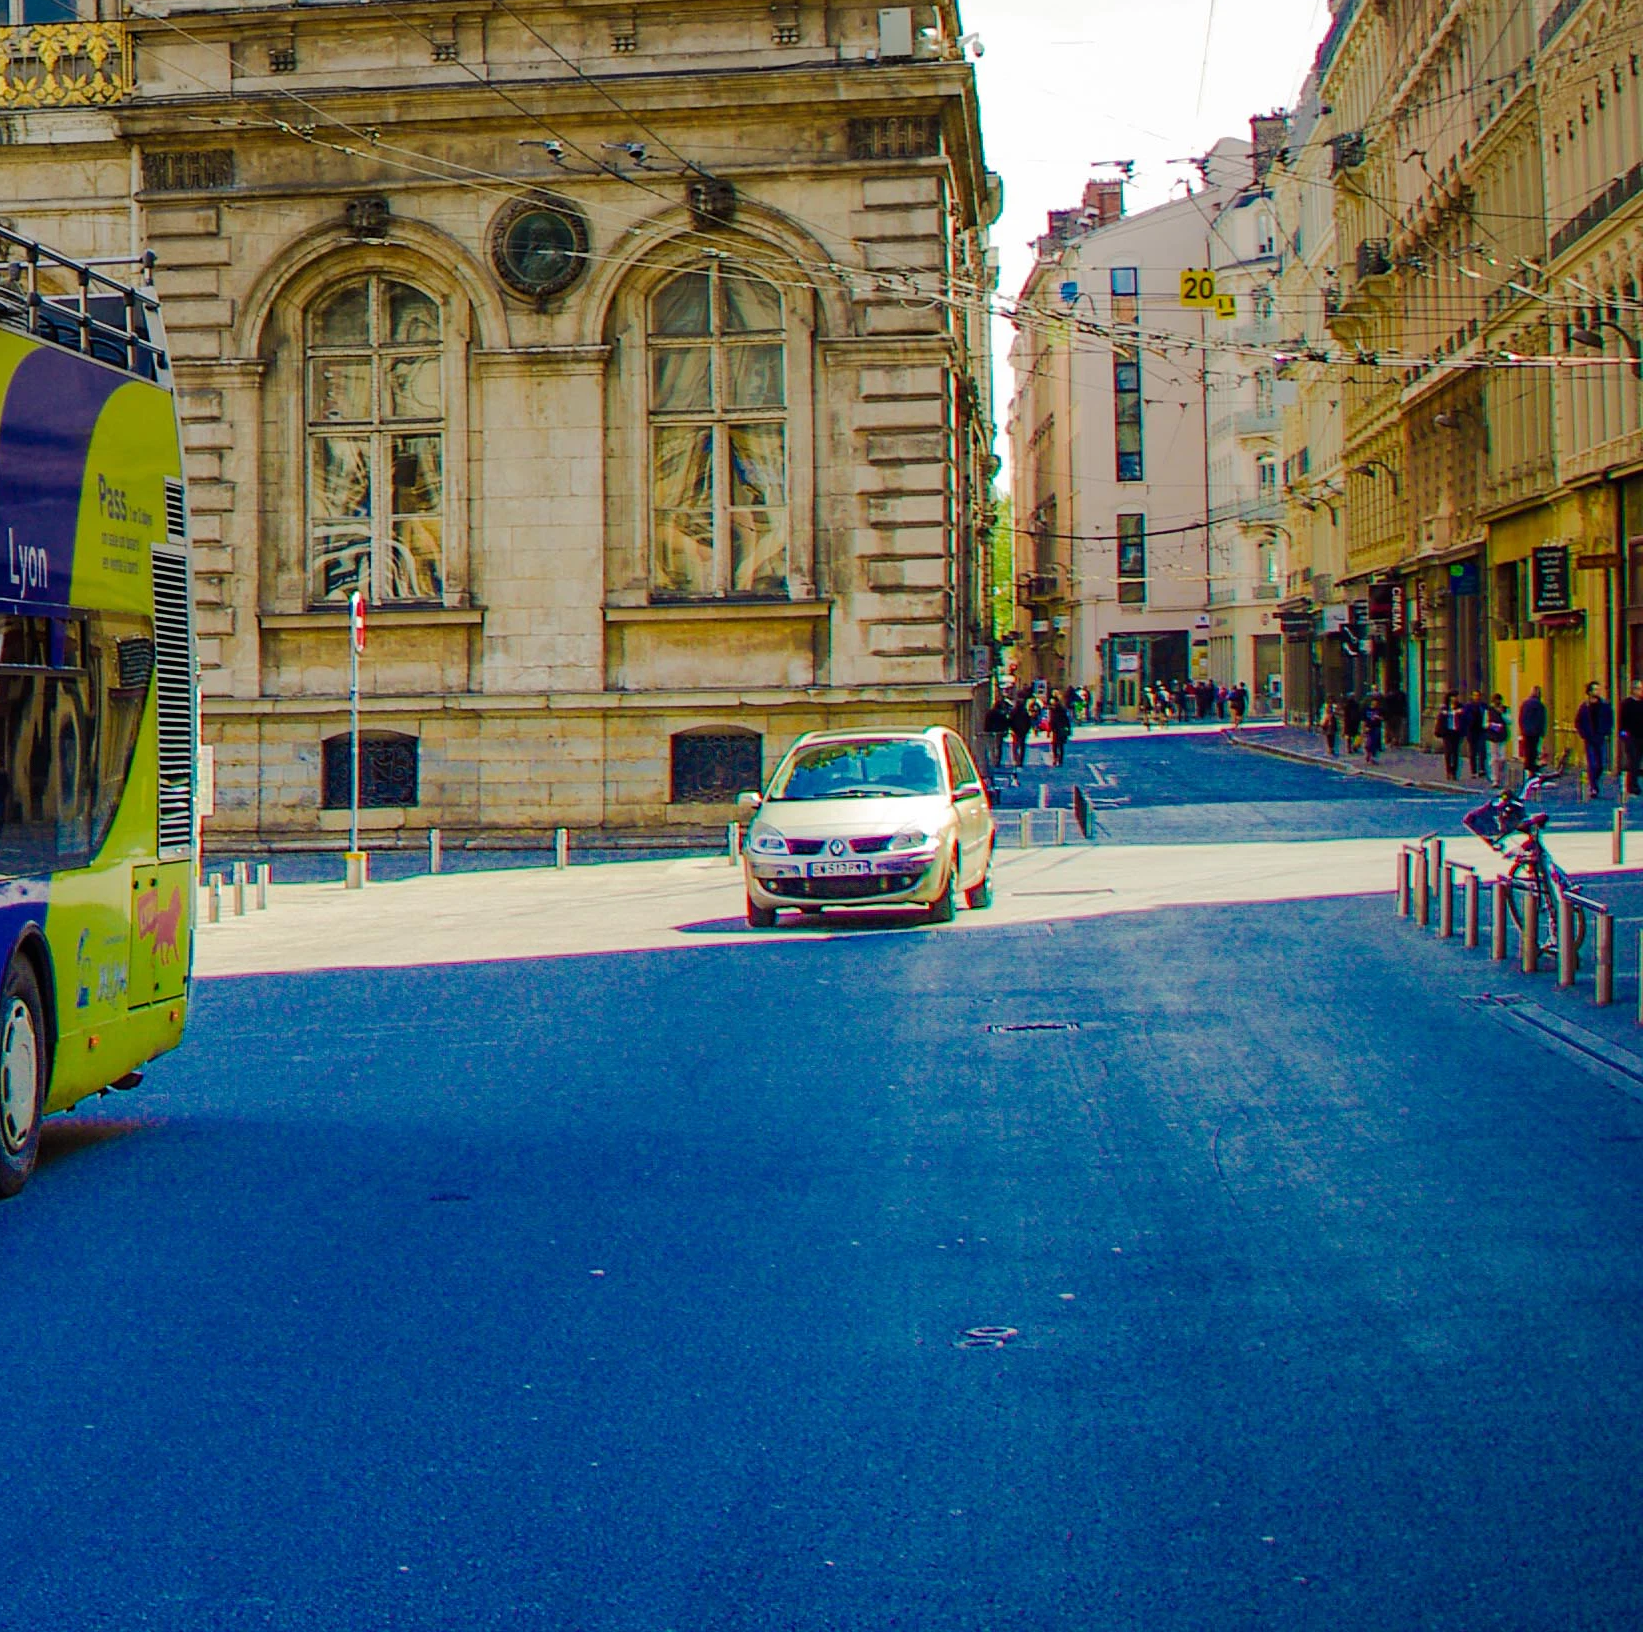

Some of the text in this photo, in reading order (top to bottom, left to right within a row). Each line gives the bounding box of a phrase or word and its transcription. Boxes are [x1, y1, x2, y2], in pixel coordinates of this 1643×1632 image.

[1183, 277, 1214, 299] 20
[98, 472, 128, 522] Pass
[8, 527, 49, 599] Lyon
